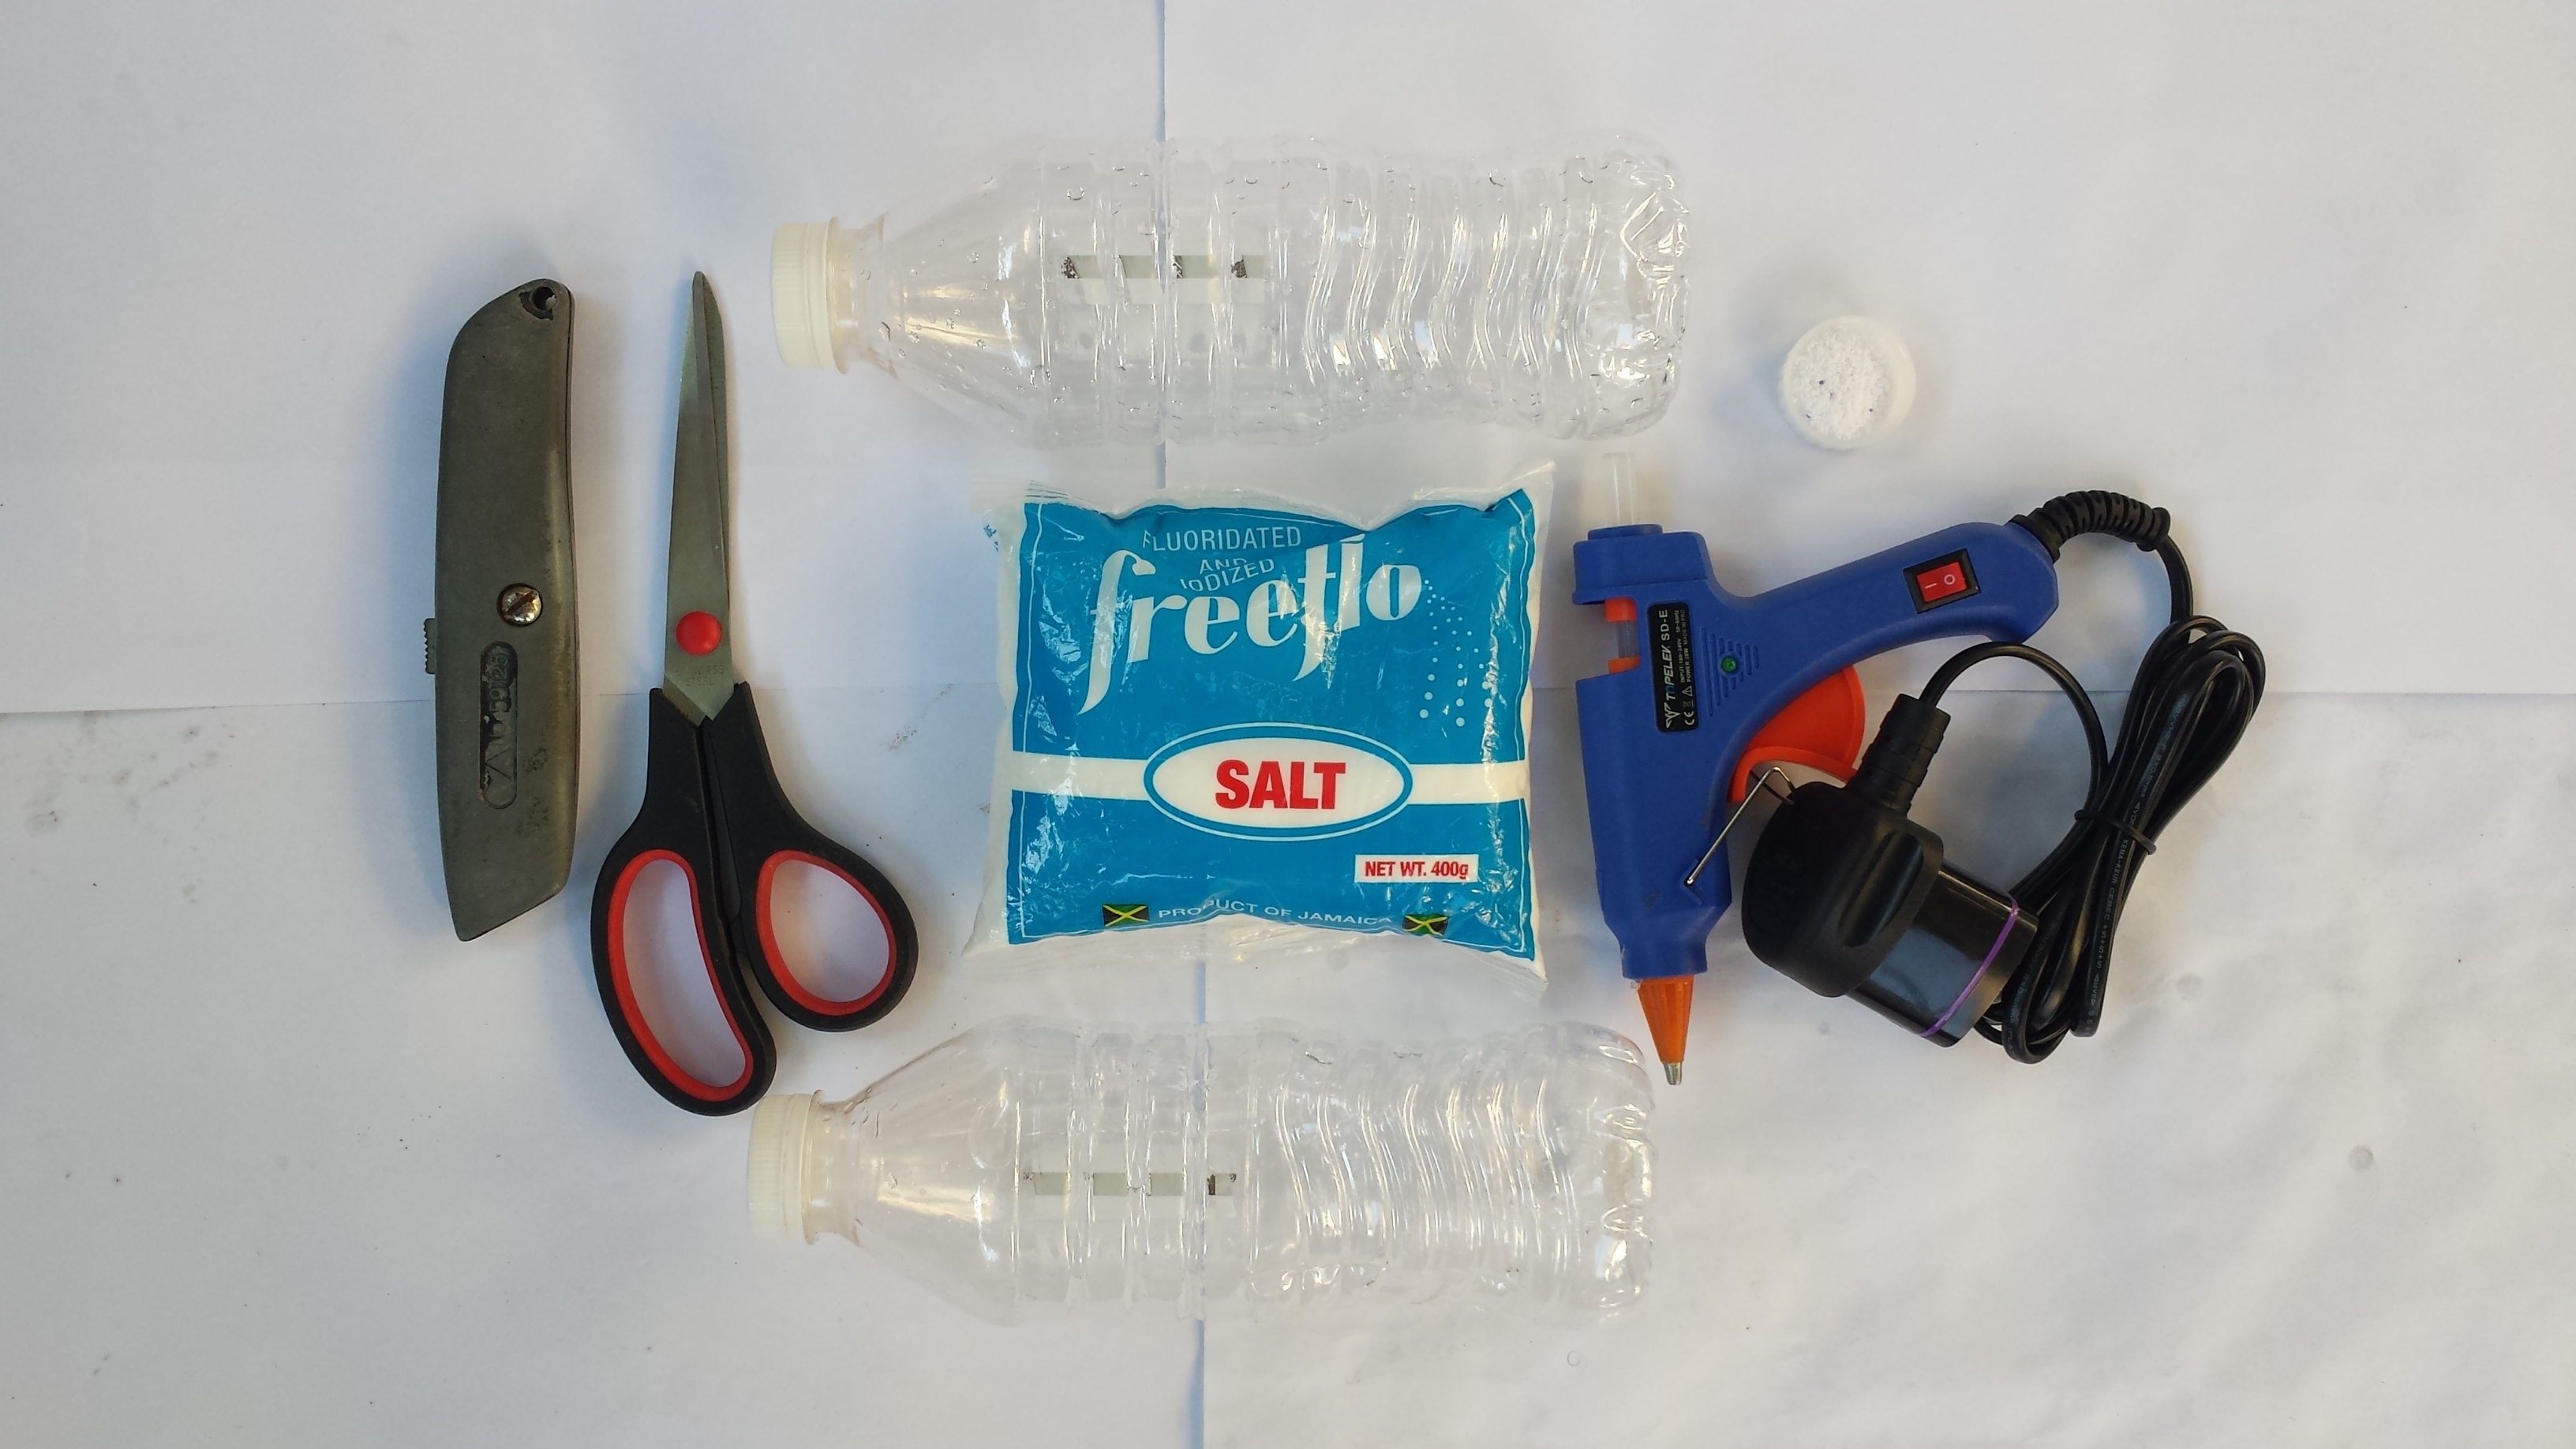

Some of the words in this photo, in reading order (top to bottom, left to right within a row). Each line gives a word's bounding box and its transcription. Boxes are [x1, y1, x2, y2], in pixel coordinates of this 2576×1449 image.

[1143, 526, 1301, 552] FLUORIDATED
[1180, 558, 1275, 592] IODIZED
[1659, 609, 1670, 641] SD-E
[1214, 759, 1346, 811] SALT
[1365, 861, 1396, 877] NET
[1400, 861, 1427, 877] WT.
[1431, 861, 1469, 880] 400g
[1264, 907, 1292, 918] OF
[1297, 910, 1392, 925] JAMAICA
